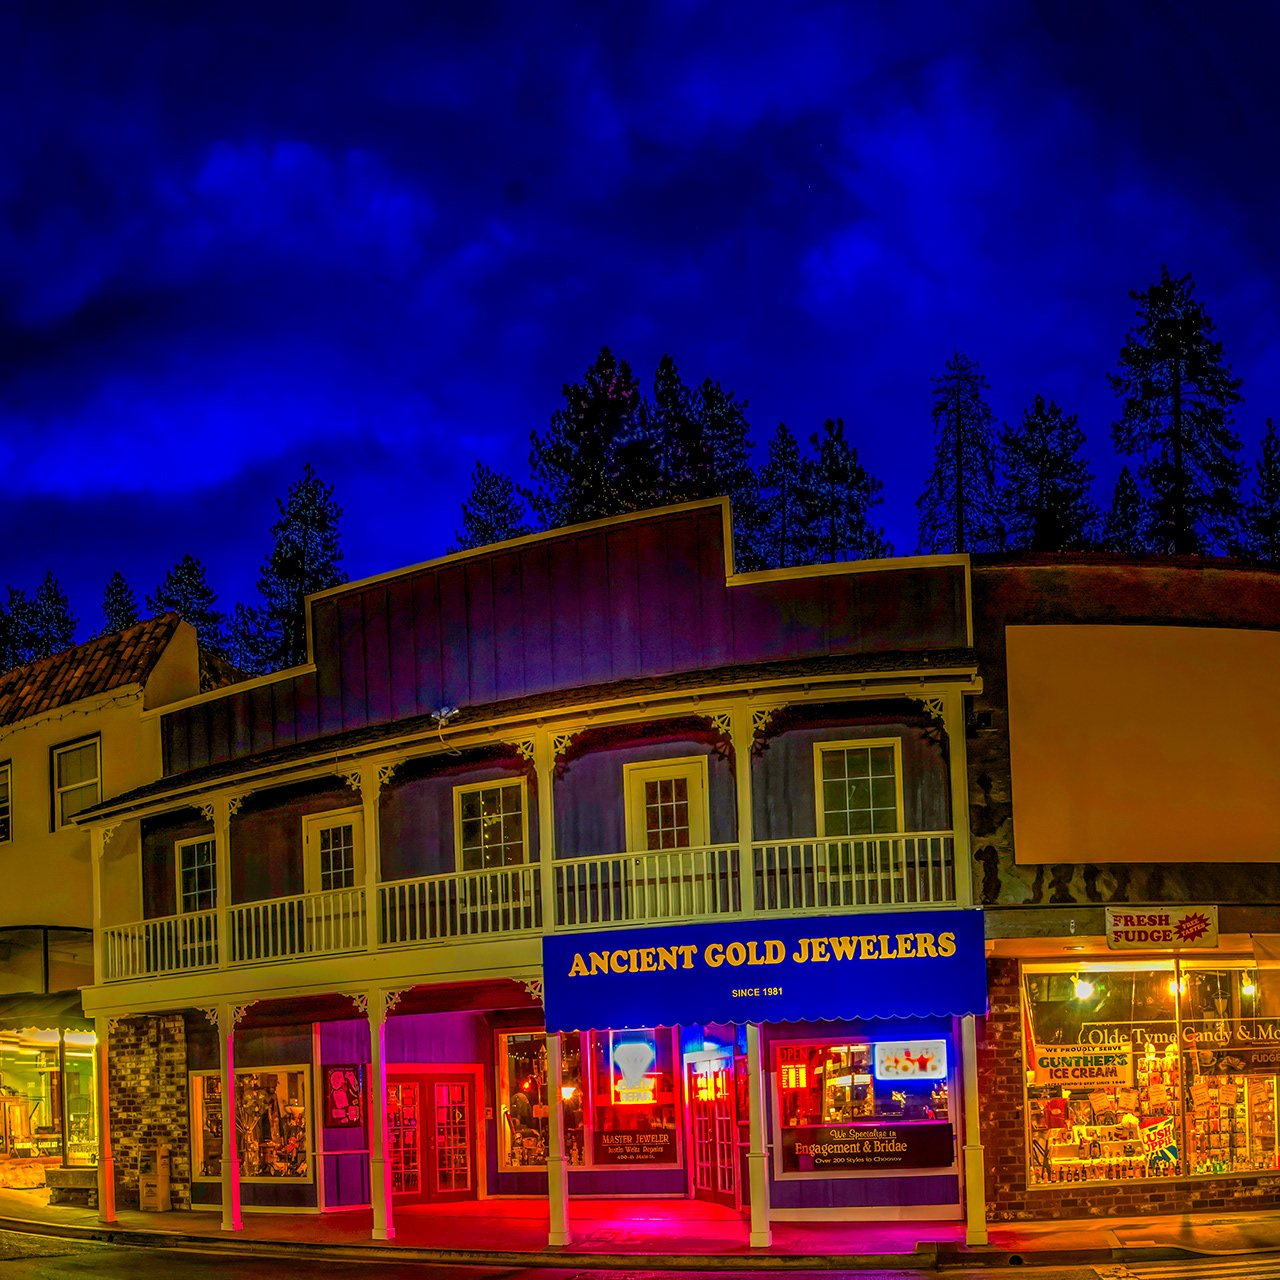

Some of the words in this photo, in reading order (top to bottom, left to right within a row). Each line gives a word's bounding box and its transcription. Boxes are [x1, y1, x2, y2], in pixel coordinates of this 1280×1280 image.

[1112, 914, 1170, 927] FRESH
[1182, 918, 1200, 929] FREE
[1113, 930, 1173, 942] FUDGE
[1181, 922, 1206, 937] TASTES
[568, 945, 698, 977] ANCIENT
[704, 940, 786, 968] GOLD
[792, 932, 957, 963] JEWELERS
[731, 988, 760, 997] SINCE
[762, 987, 783, 996] 1981
[1088, 1028, 1128, 1045] Olde
[1132, 1028, 1177, 1047] Tyme
[1182, 1026, 1233, 1045] Candy
[1237, 1025, 1252, 1040] &
[779, 1047, 809, 1061] OPEN
[1038, 1054, 1128, 1068] GUNTHER'S
[880, 1060, 941, 1076] GOLD
[1049, 1068, 1069, 1079] ICE
[1071, 1066, 1118, 1079] CREAM
[620, 1090, 652, 1102] REPAIR
[602, 1135, 632, 1144] MASTER
[635, 1134, 669, 1143] JEWELER
[830, 1129, 847, 1139] We
[795, 1142, 861, 1157] Engagement
[862, 1141, 872, 1153] &
